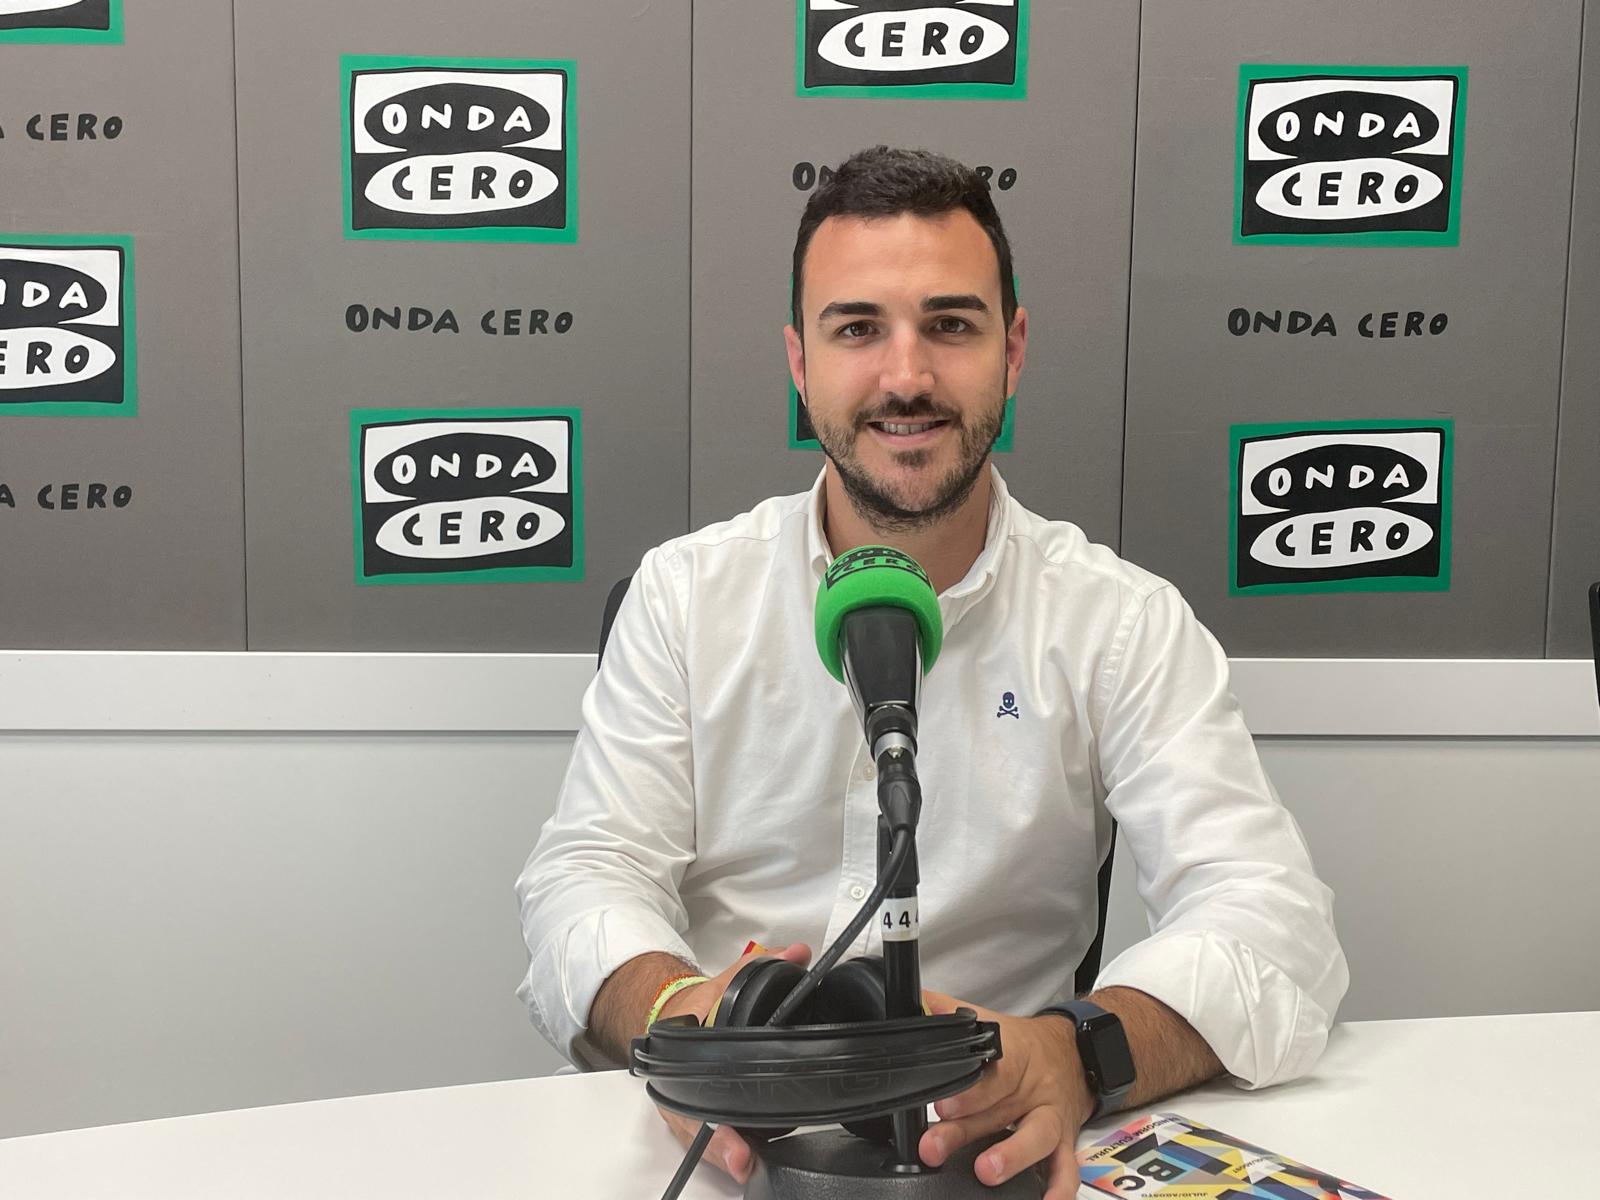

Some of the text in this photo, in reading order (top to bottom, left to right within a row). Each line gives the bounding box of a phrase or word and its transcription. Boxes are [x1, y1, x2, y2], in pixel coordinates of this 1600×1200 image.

[845, 21, 985, 58] CERO
[26, 113, 123, 141] CERO
[381, 103, 532, 135] ONDA
[1276, 110, 1421, 142] ONDA
[392, 165, 533, 200] CERO
[975, 166, 1017, 191] RO
[1282, 171, 1419, 206] CERO
[0, 278, 88, 309] DA
[345, 304, 574, 336] ONDA CERO
[1227, 308, 1448, 338] ONDA CERO
[391, 452, 539, 484] ONDA
[1268, 463, 1410, 496] ONDA
[37, 483, 132, 510] CERO
[402, 510, 540, 546] CERO
[1275, 520, 1410, 556] CERO
[1086, 1135, 1134, 1162] CULTURAL
